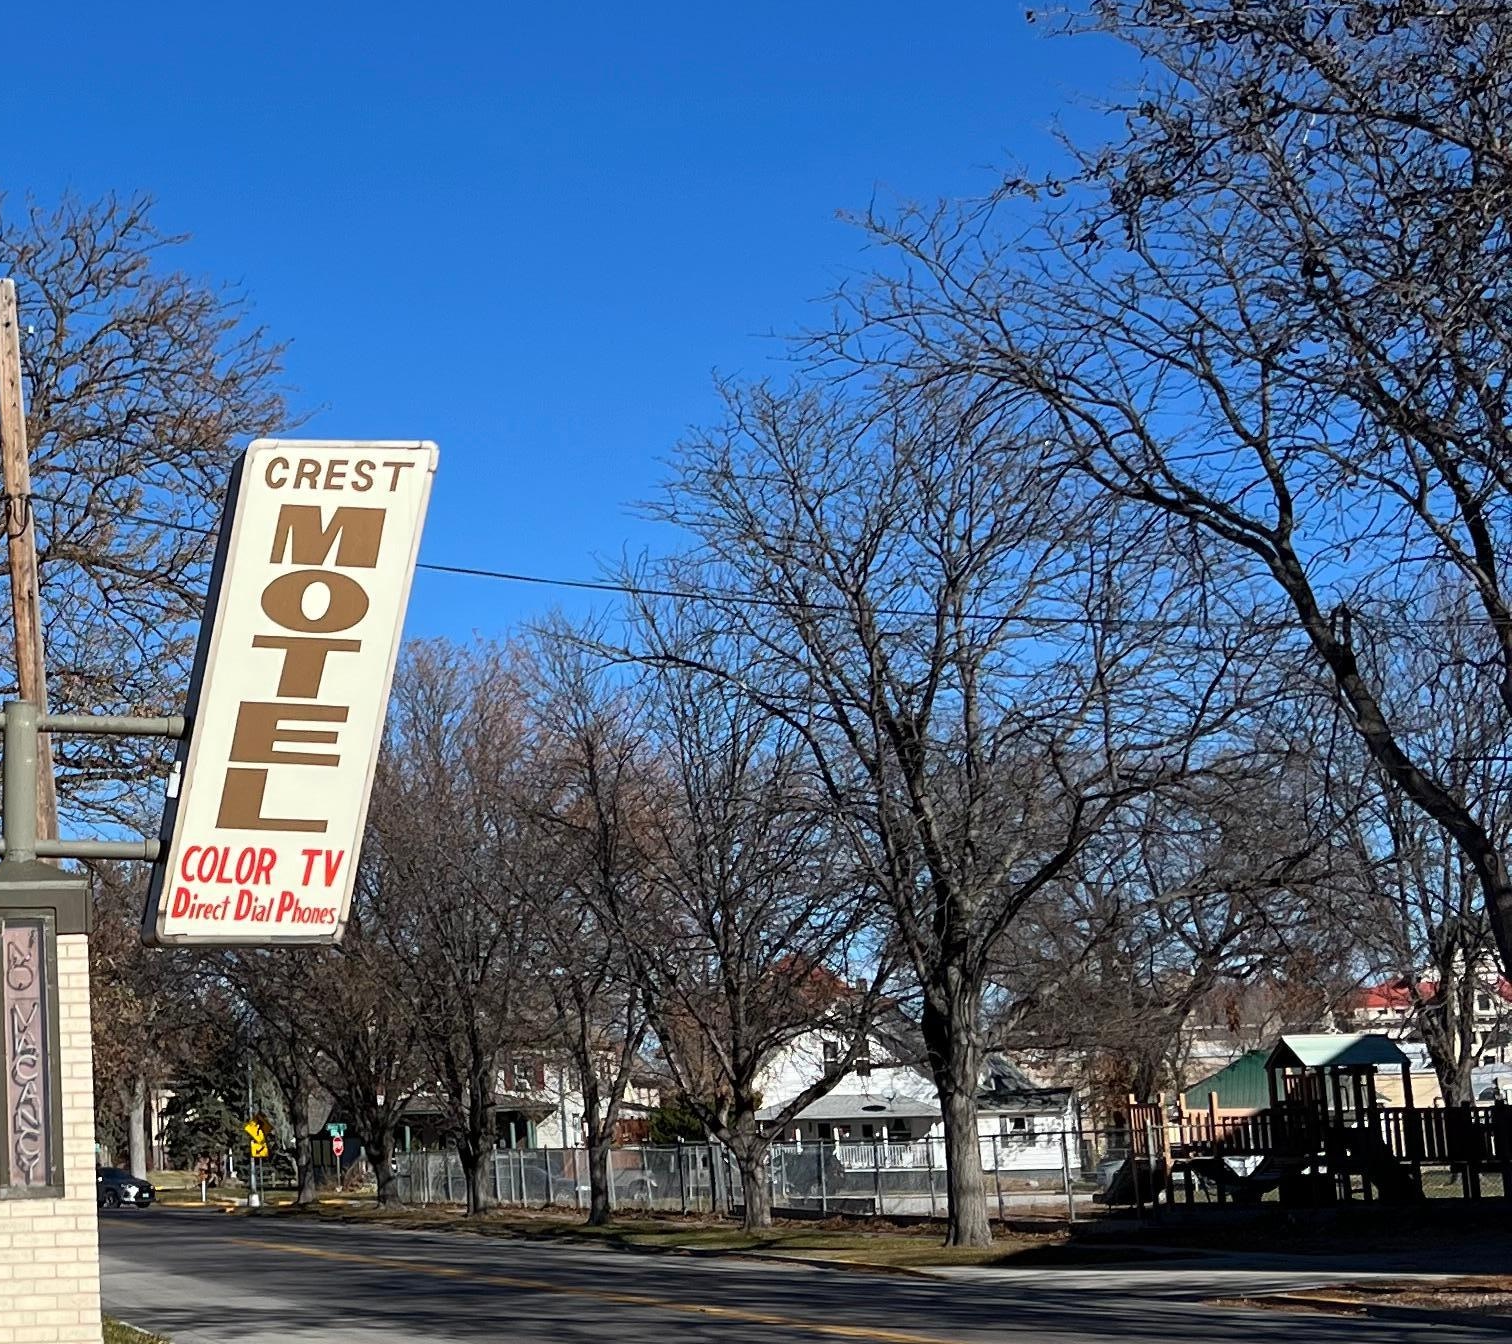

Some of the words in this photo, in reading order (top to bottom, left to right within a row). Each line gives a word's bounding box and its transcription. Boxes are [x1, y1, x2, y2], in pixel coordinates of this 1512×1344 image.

[264, 456, 415, 493] CREST
[215, 503, 387, 833] MOTEL
[180, 845, 278, 885] COLOR
[302, 848, 345, 888] TV
[171, 886, 231, 921] Direct
[233, 887, 275, 922] Dial
[275, 890, 337, 925] Phones
[6, 929, 35, 991] NO
[10, 1001, 41, 1185] VACANCY
